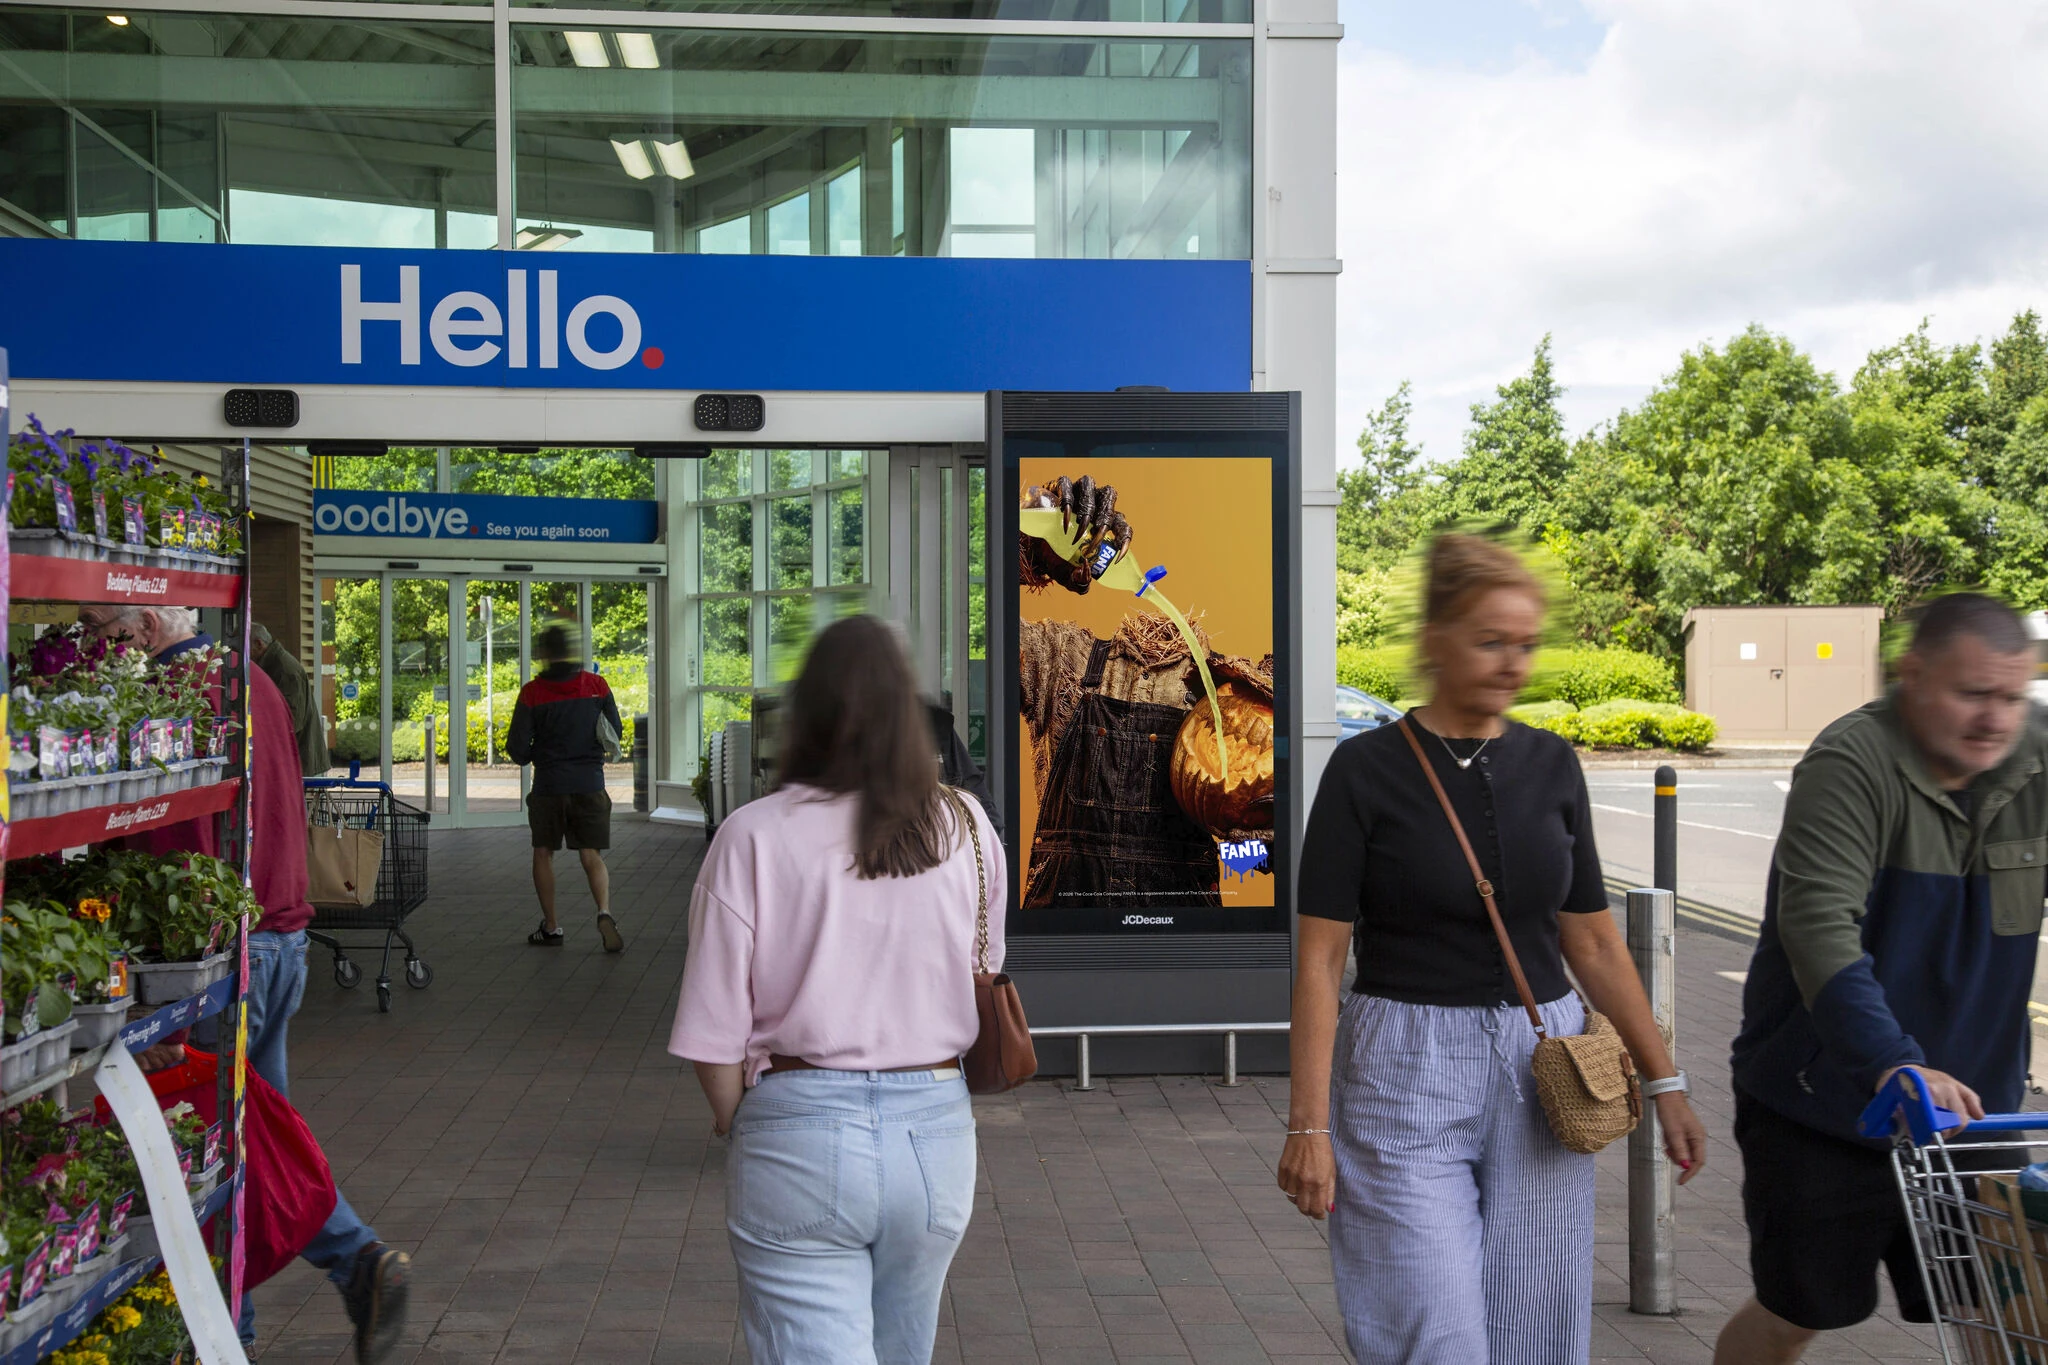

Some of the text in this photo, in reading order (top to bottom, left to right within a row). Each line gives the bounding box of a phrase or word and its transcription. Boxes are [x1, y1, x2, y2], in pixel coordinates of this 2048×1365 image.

[341, 264, 665, 370] Hello.
[315, 496, 609, 539] oodbye. See you again soon
[106, 572, 133, 597] Bedding
[132, 575, 151, 593] Plants
[105, 810, 134, 830] Bedding
[132, 806, 152, 824] Plants
[1220, 840, 1268, 860] FANTA
[1122, 914, 1174, 925] JCDecaux
